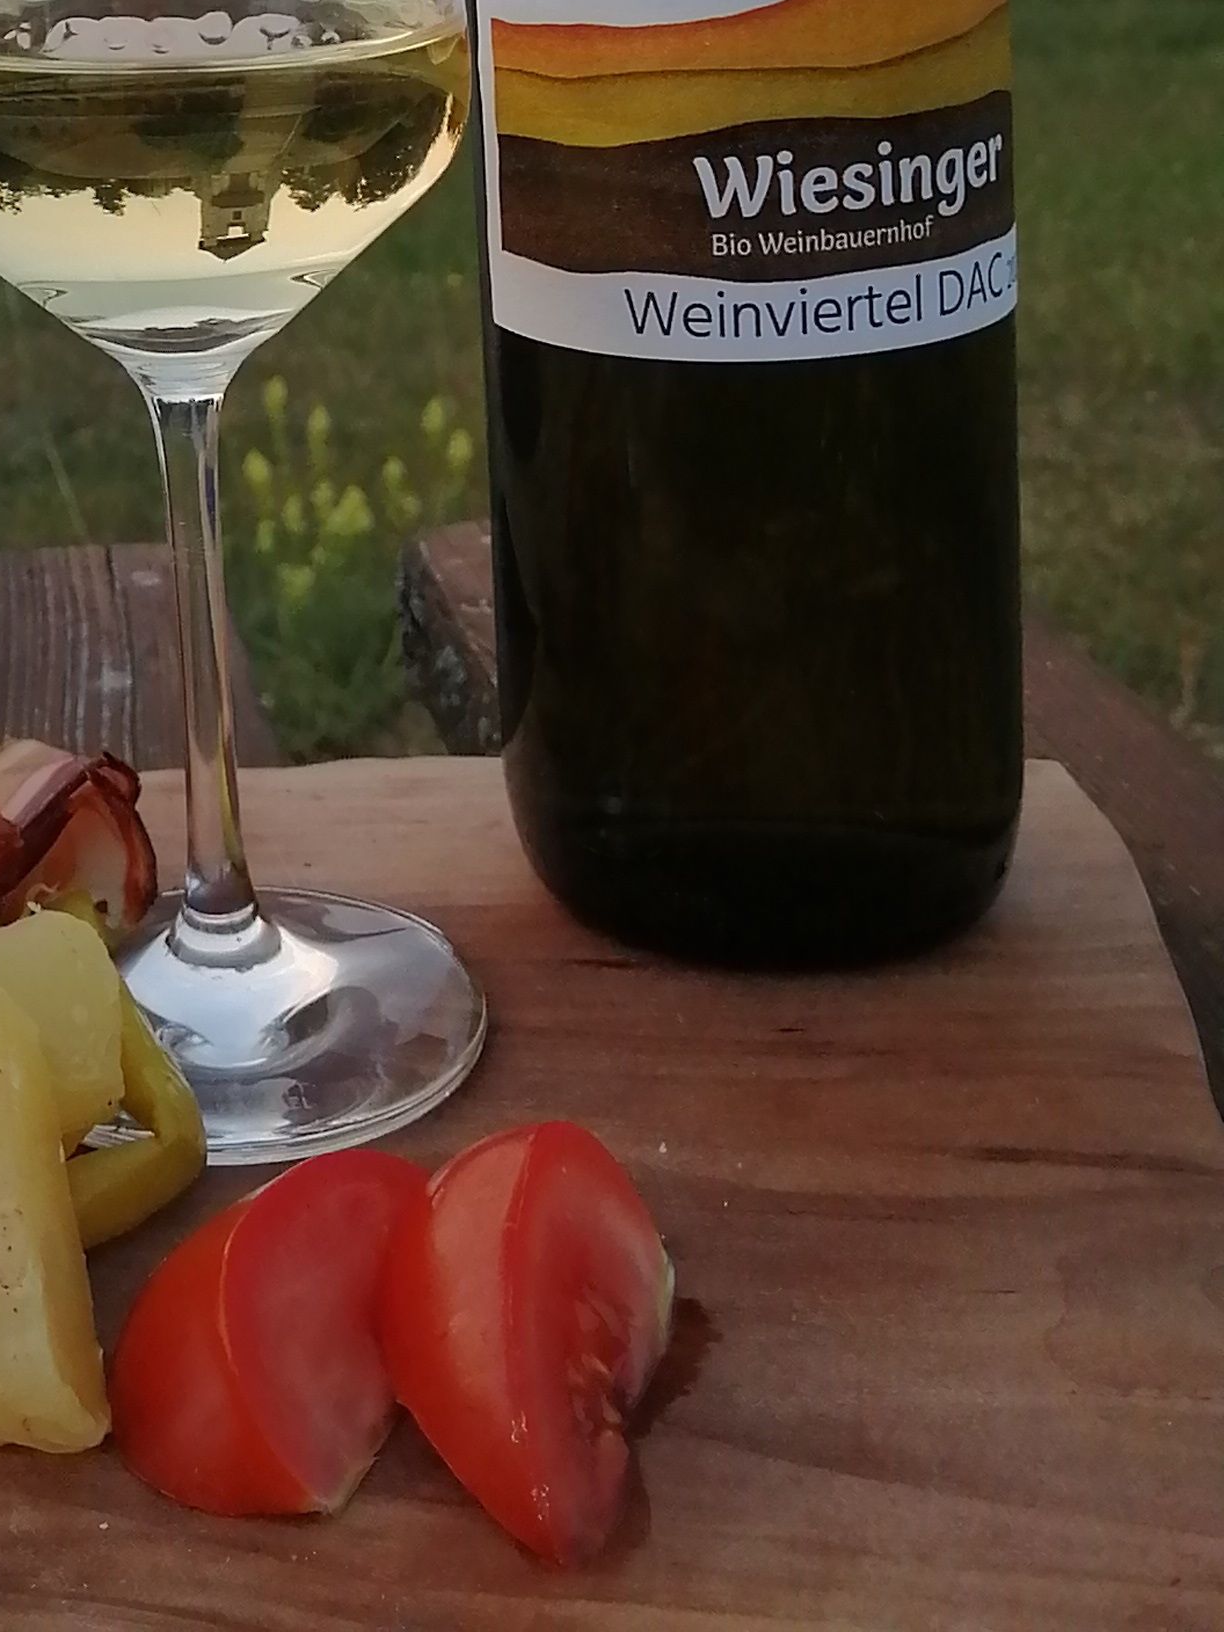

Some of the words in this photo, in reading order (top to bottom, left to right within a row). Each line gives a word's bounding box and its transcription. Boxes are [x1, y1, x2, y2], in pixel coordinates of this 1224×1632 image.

[692, 133, 1004, 217] Wiesinger
[711, 232, 752, 257] Bio
[757, 215, 935, 255] Weinbauernhof
[623, 272, 923, 338] Weinviertel
[939, 251, 1004, 317] DAC
